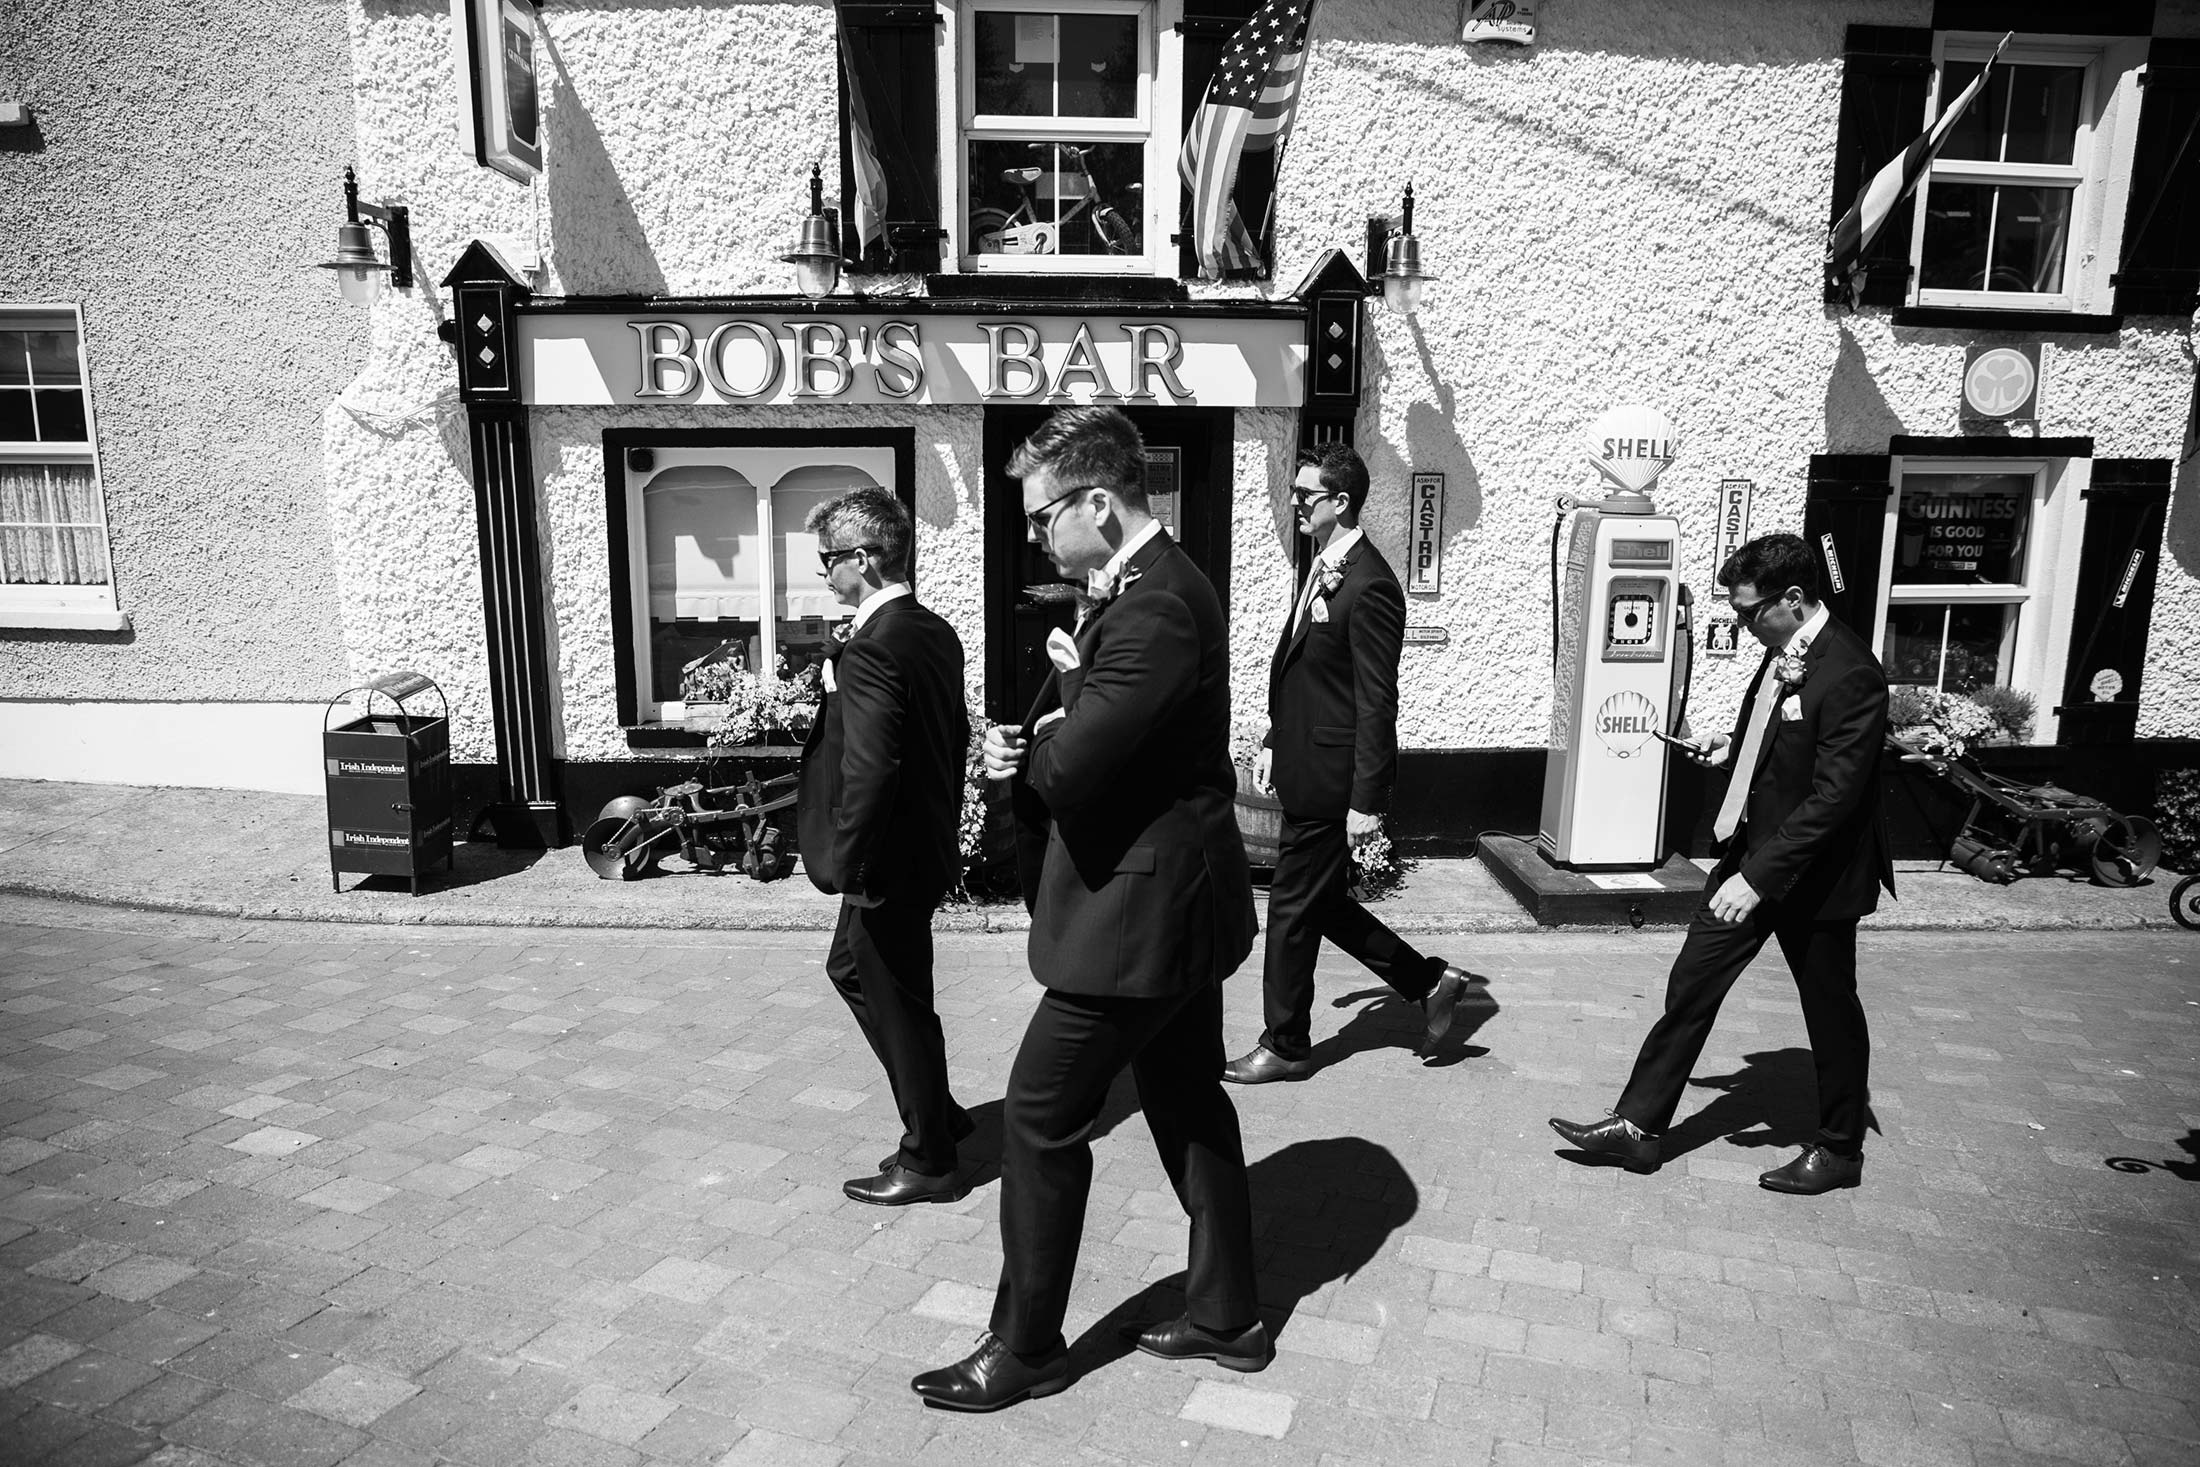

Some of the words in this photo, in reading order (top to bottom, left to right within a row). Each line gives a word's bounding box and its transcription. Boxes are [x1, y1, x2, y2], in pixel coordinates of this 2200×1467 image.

[627, 320, 922, 398] BOB'S
[977, 322, 1196, 399] BAR
[1601, 437, 1672, 460] SHELL
[1906, 493, 2017, 519] GUINNESS
[1418, 485, 1436, 583] CASTROL
[1930, 526, 1943, 538] IS
[1945, 526, 1986, 538] GOOD
[1927, 545, 1953, 557] FOR
[1956, 545, 1984, 557] YOU
[1827, 549, 1842, 589] MICHELIN
[2121, 552, 2141, 593] MICHELIN
[1602, 716, 1650, 733] SHELL
[340, 762, 360, 771] Irish
[361, 763, 406, 775] Independent
[345, 833, 364, 843] Irish
[365, 835, 410, 846] Independent
